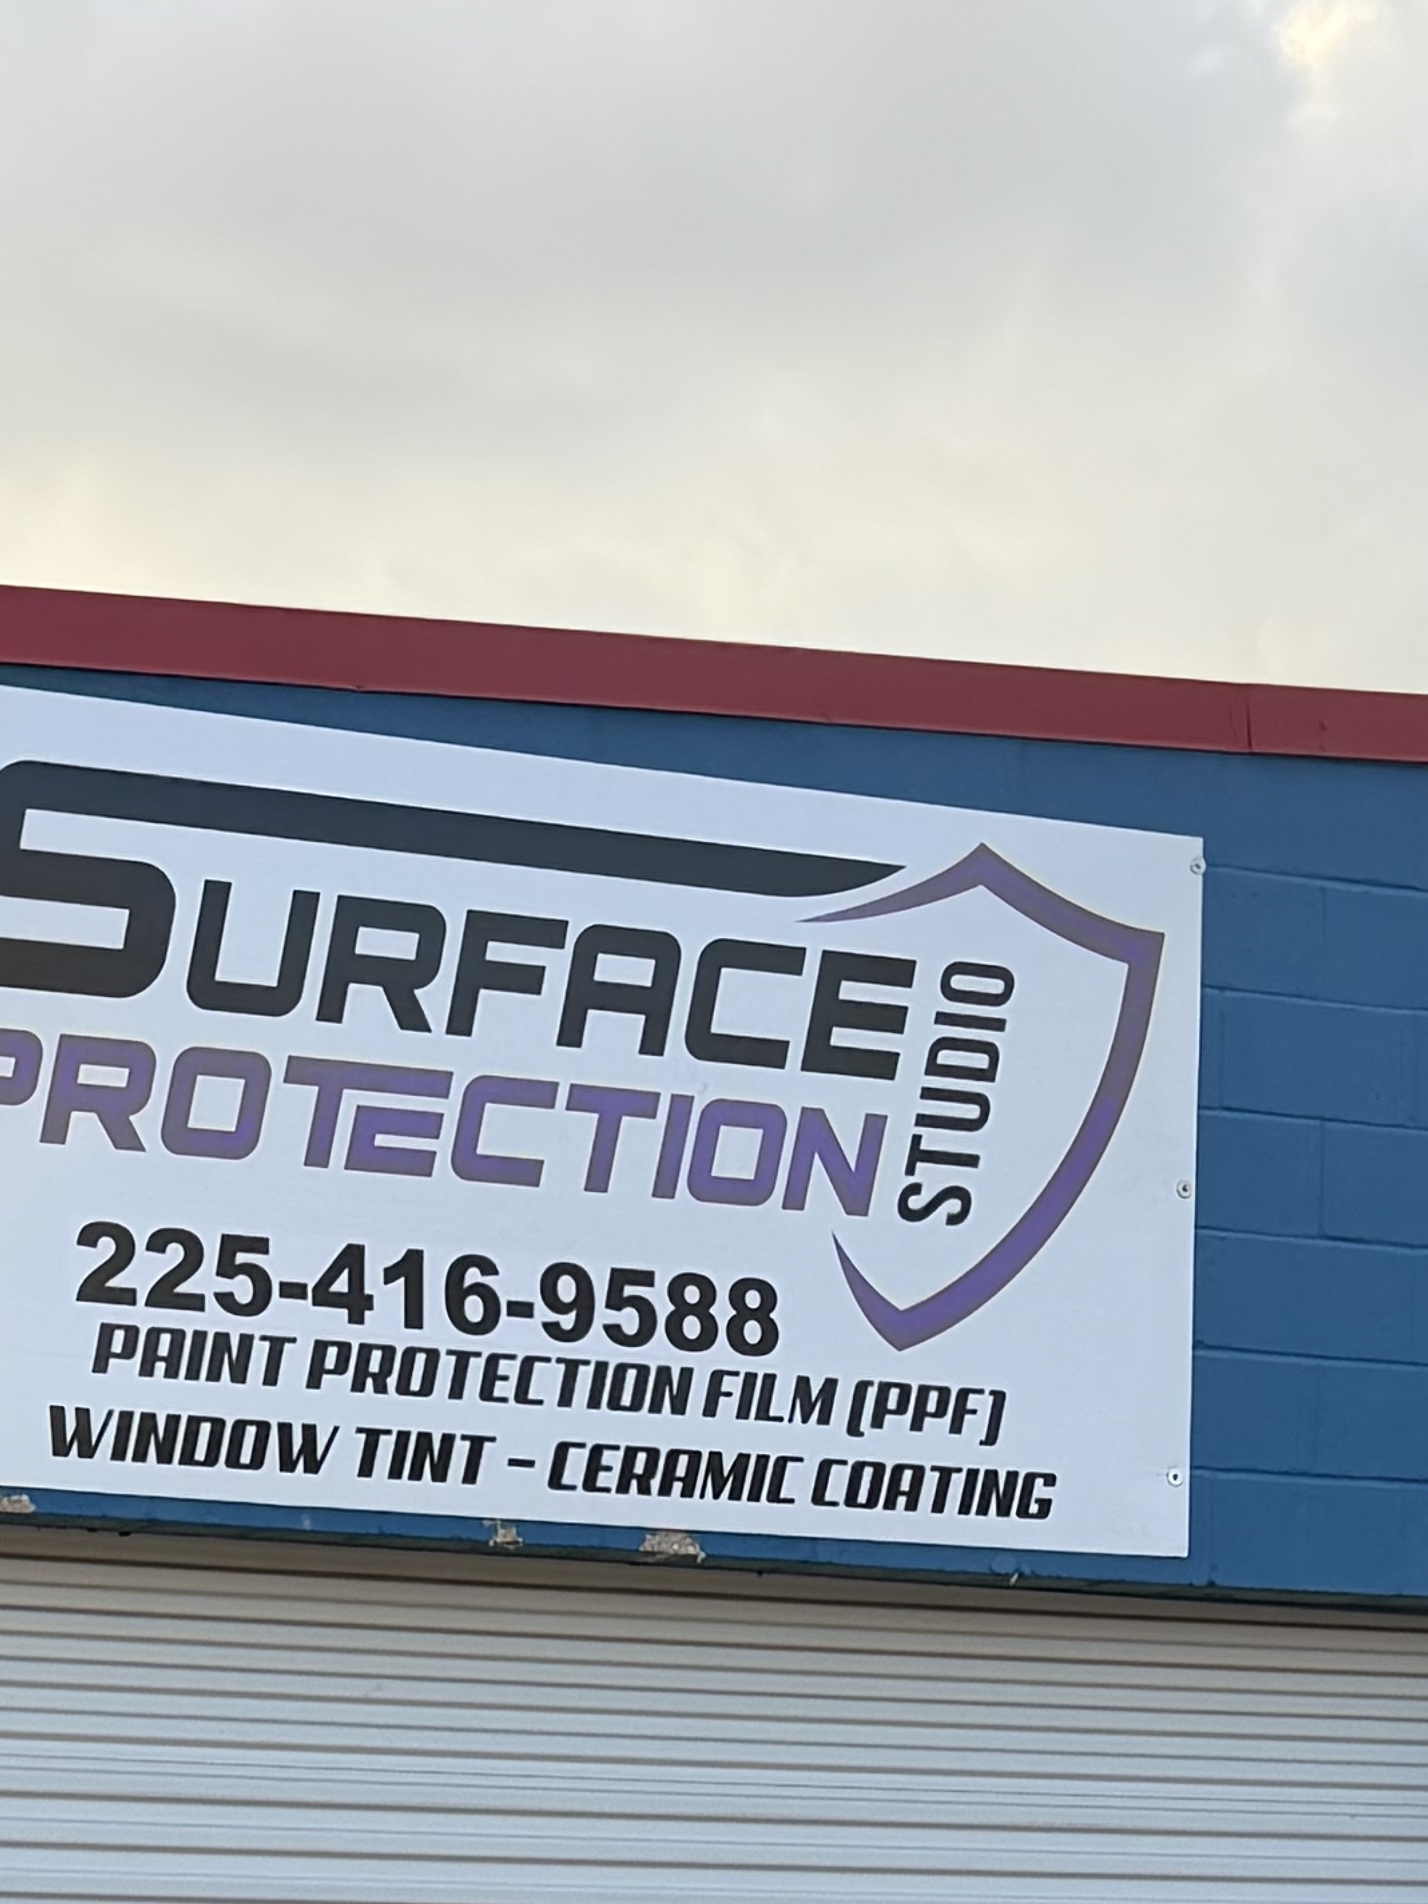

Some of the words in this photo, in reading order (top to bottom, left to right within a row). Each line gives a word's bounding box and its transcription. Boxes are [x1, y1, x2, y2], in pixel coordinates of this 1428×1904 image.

[898, 961, 1014, 1226] STUDIO
[76, 1222, 779, 1356] 225-416-9588
[92, 1323, 297, 1387] PAINT
[306, 1339, 694, 1415] PROTECTION
[702, 1370, 838, 1425] FILM
[50, 1405, 340, 1474] WINDOW
[355, 1427, 496, 1485] TINT
[508, 1458, 535, 1468] -
[548, 1441, 804, 1504] CERAMIC
[811, 1458, 1057, 1519] COATING
